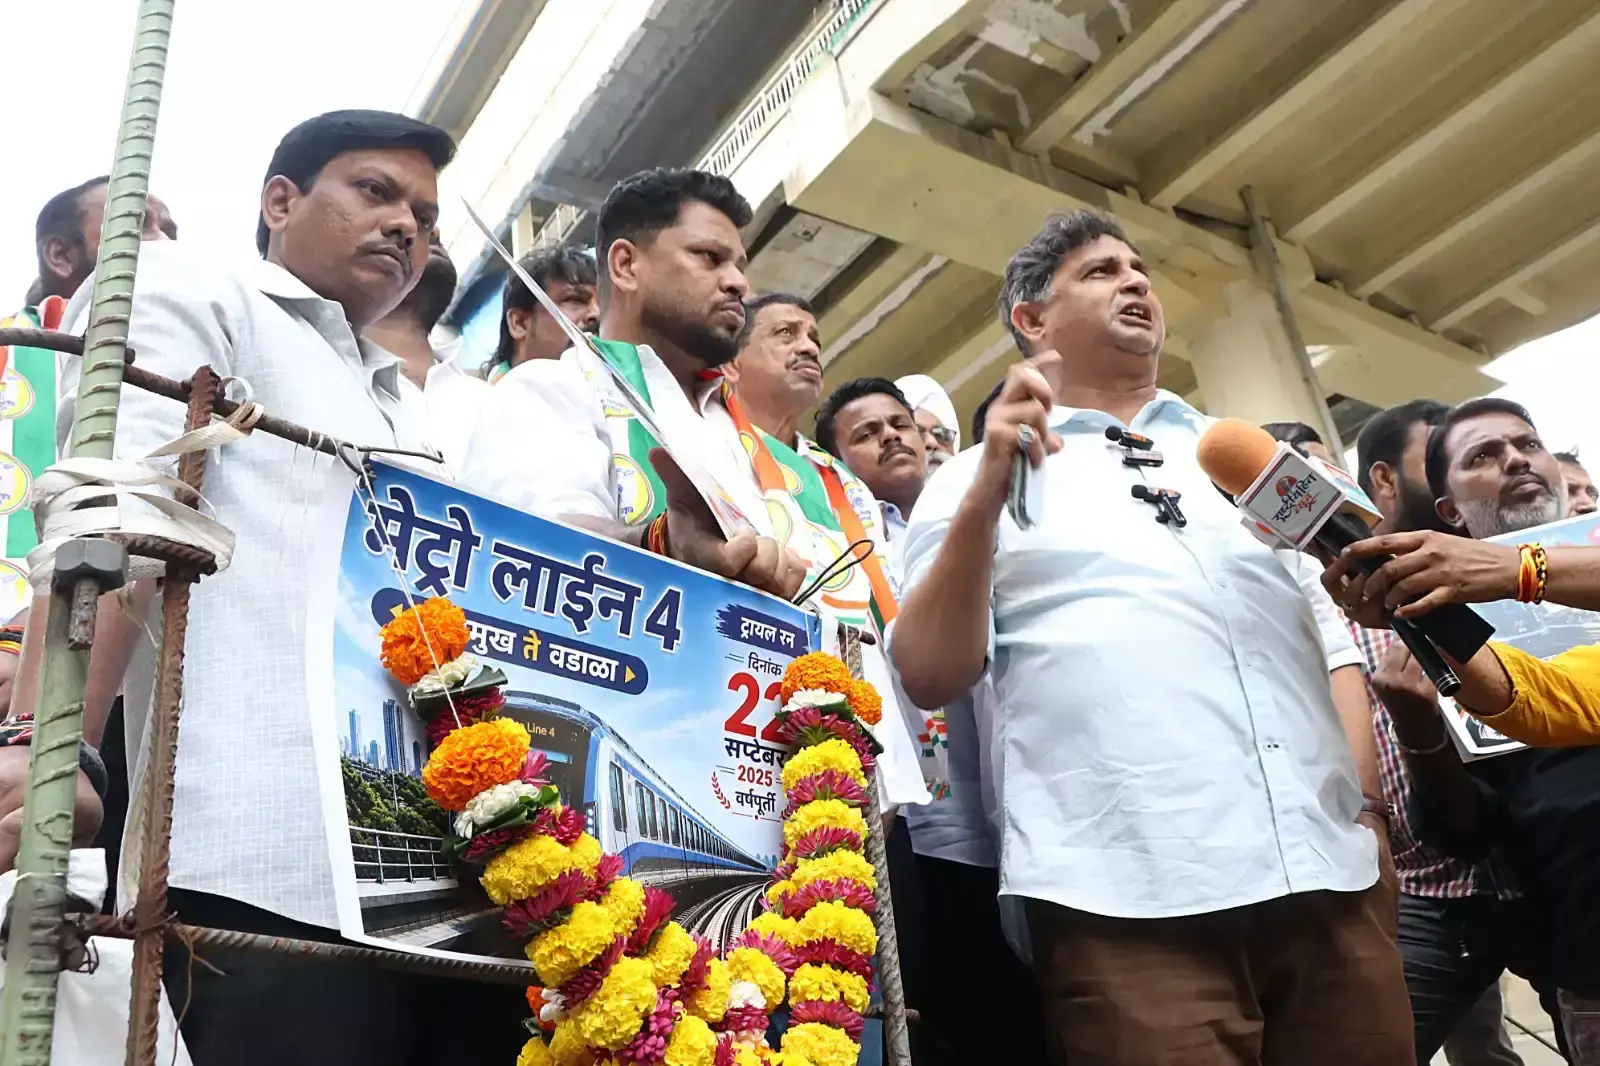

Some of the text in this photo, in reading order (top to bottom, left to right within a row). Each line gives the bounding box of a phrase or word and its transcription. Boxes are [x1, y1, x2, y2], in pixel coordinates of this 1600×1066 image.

[363, 485, 684, 654] मेट्रो लाईन 4
[740, 616, 796, 649] ट्रायल रन
[463, 619, 619, 682] मुख ते वडाळा
[748, 651, 783, 677] दिनांक
[724, 671, 792, 746] 22
[526, 721, 547, 736] Line
[548, 726, 555, 738] 4
[737, 764, 773, 788] 2025
[735, 788, 777, 816] वर्षपूर्ती
